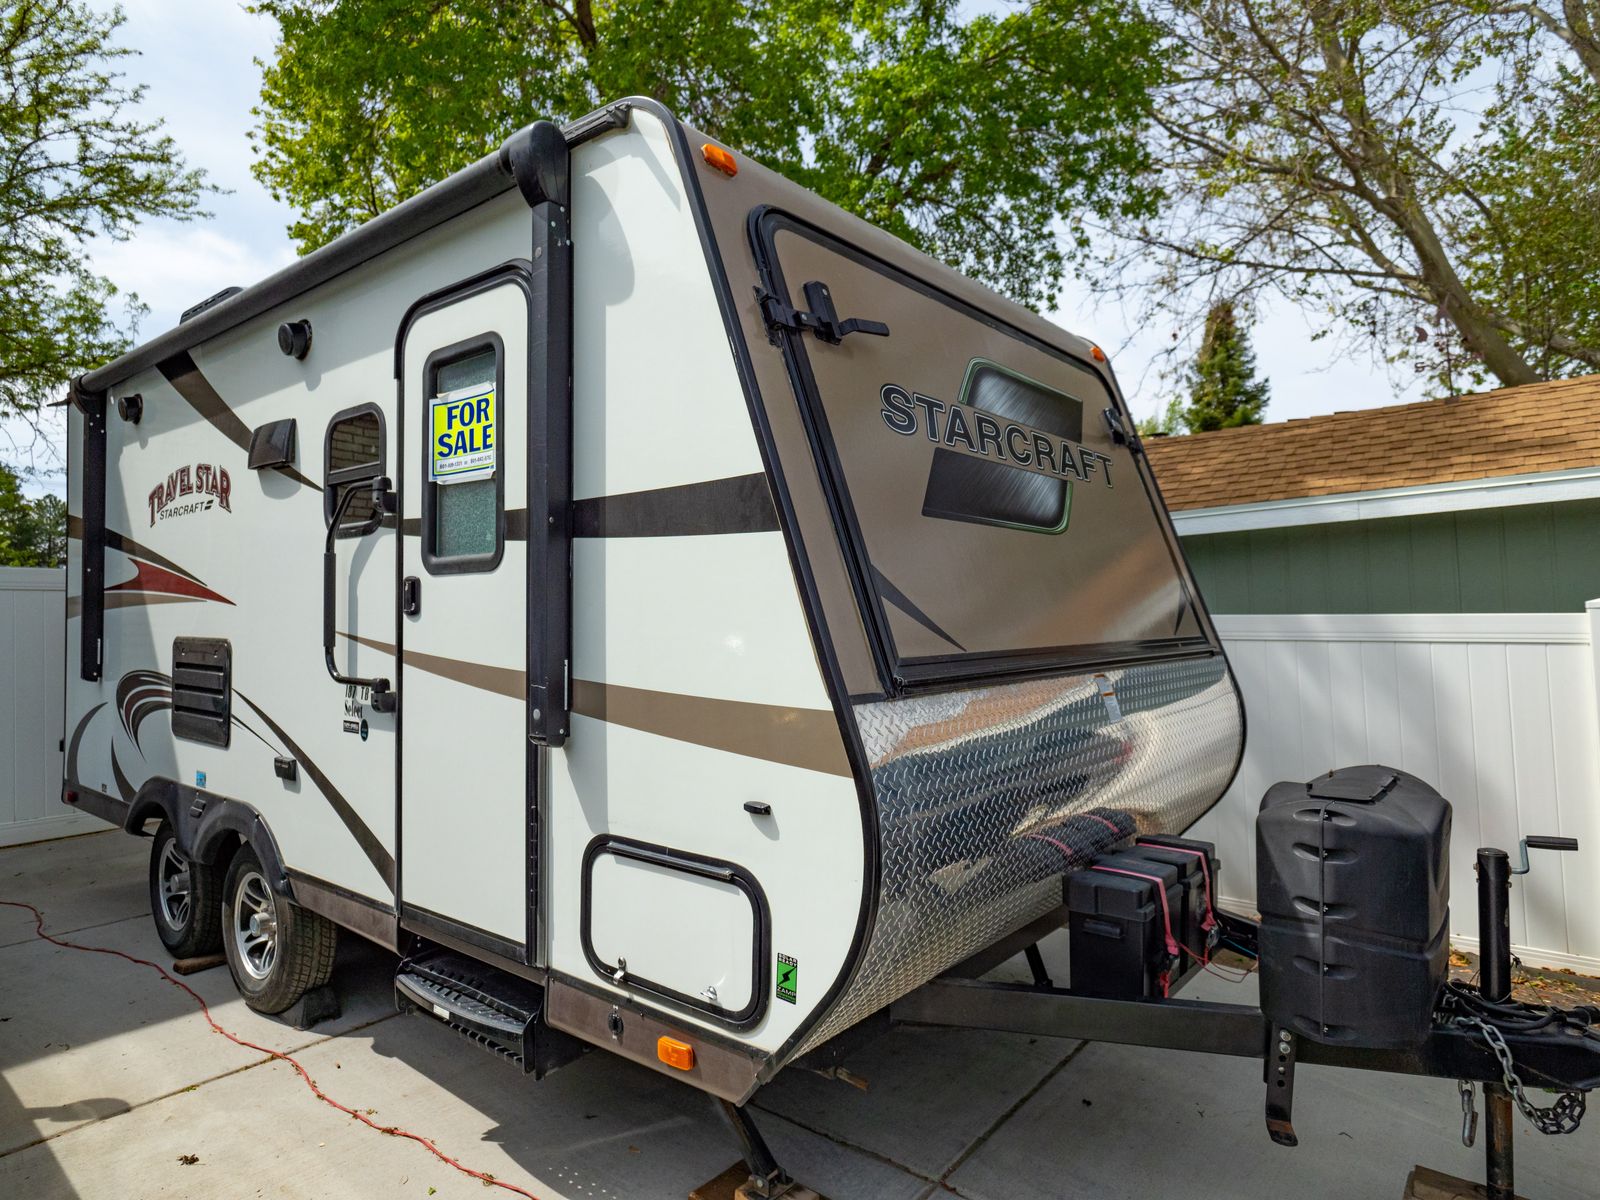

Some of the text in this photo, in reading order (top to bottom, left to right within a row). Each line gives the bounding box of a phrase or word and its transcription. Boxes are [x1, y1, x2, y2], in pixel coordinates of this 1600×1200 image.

[446, 397, 490, 430] FOR
[437, 424, 493, 458] SALE
[881, 383, 1113, 488] STARCRAFT
[148, 463, 232, 528] TRAVEL STAR
[159, 501, 205, 521] STARCRAFT
[777, 986, 797, 997] ZAMP
